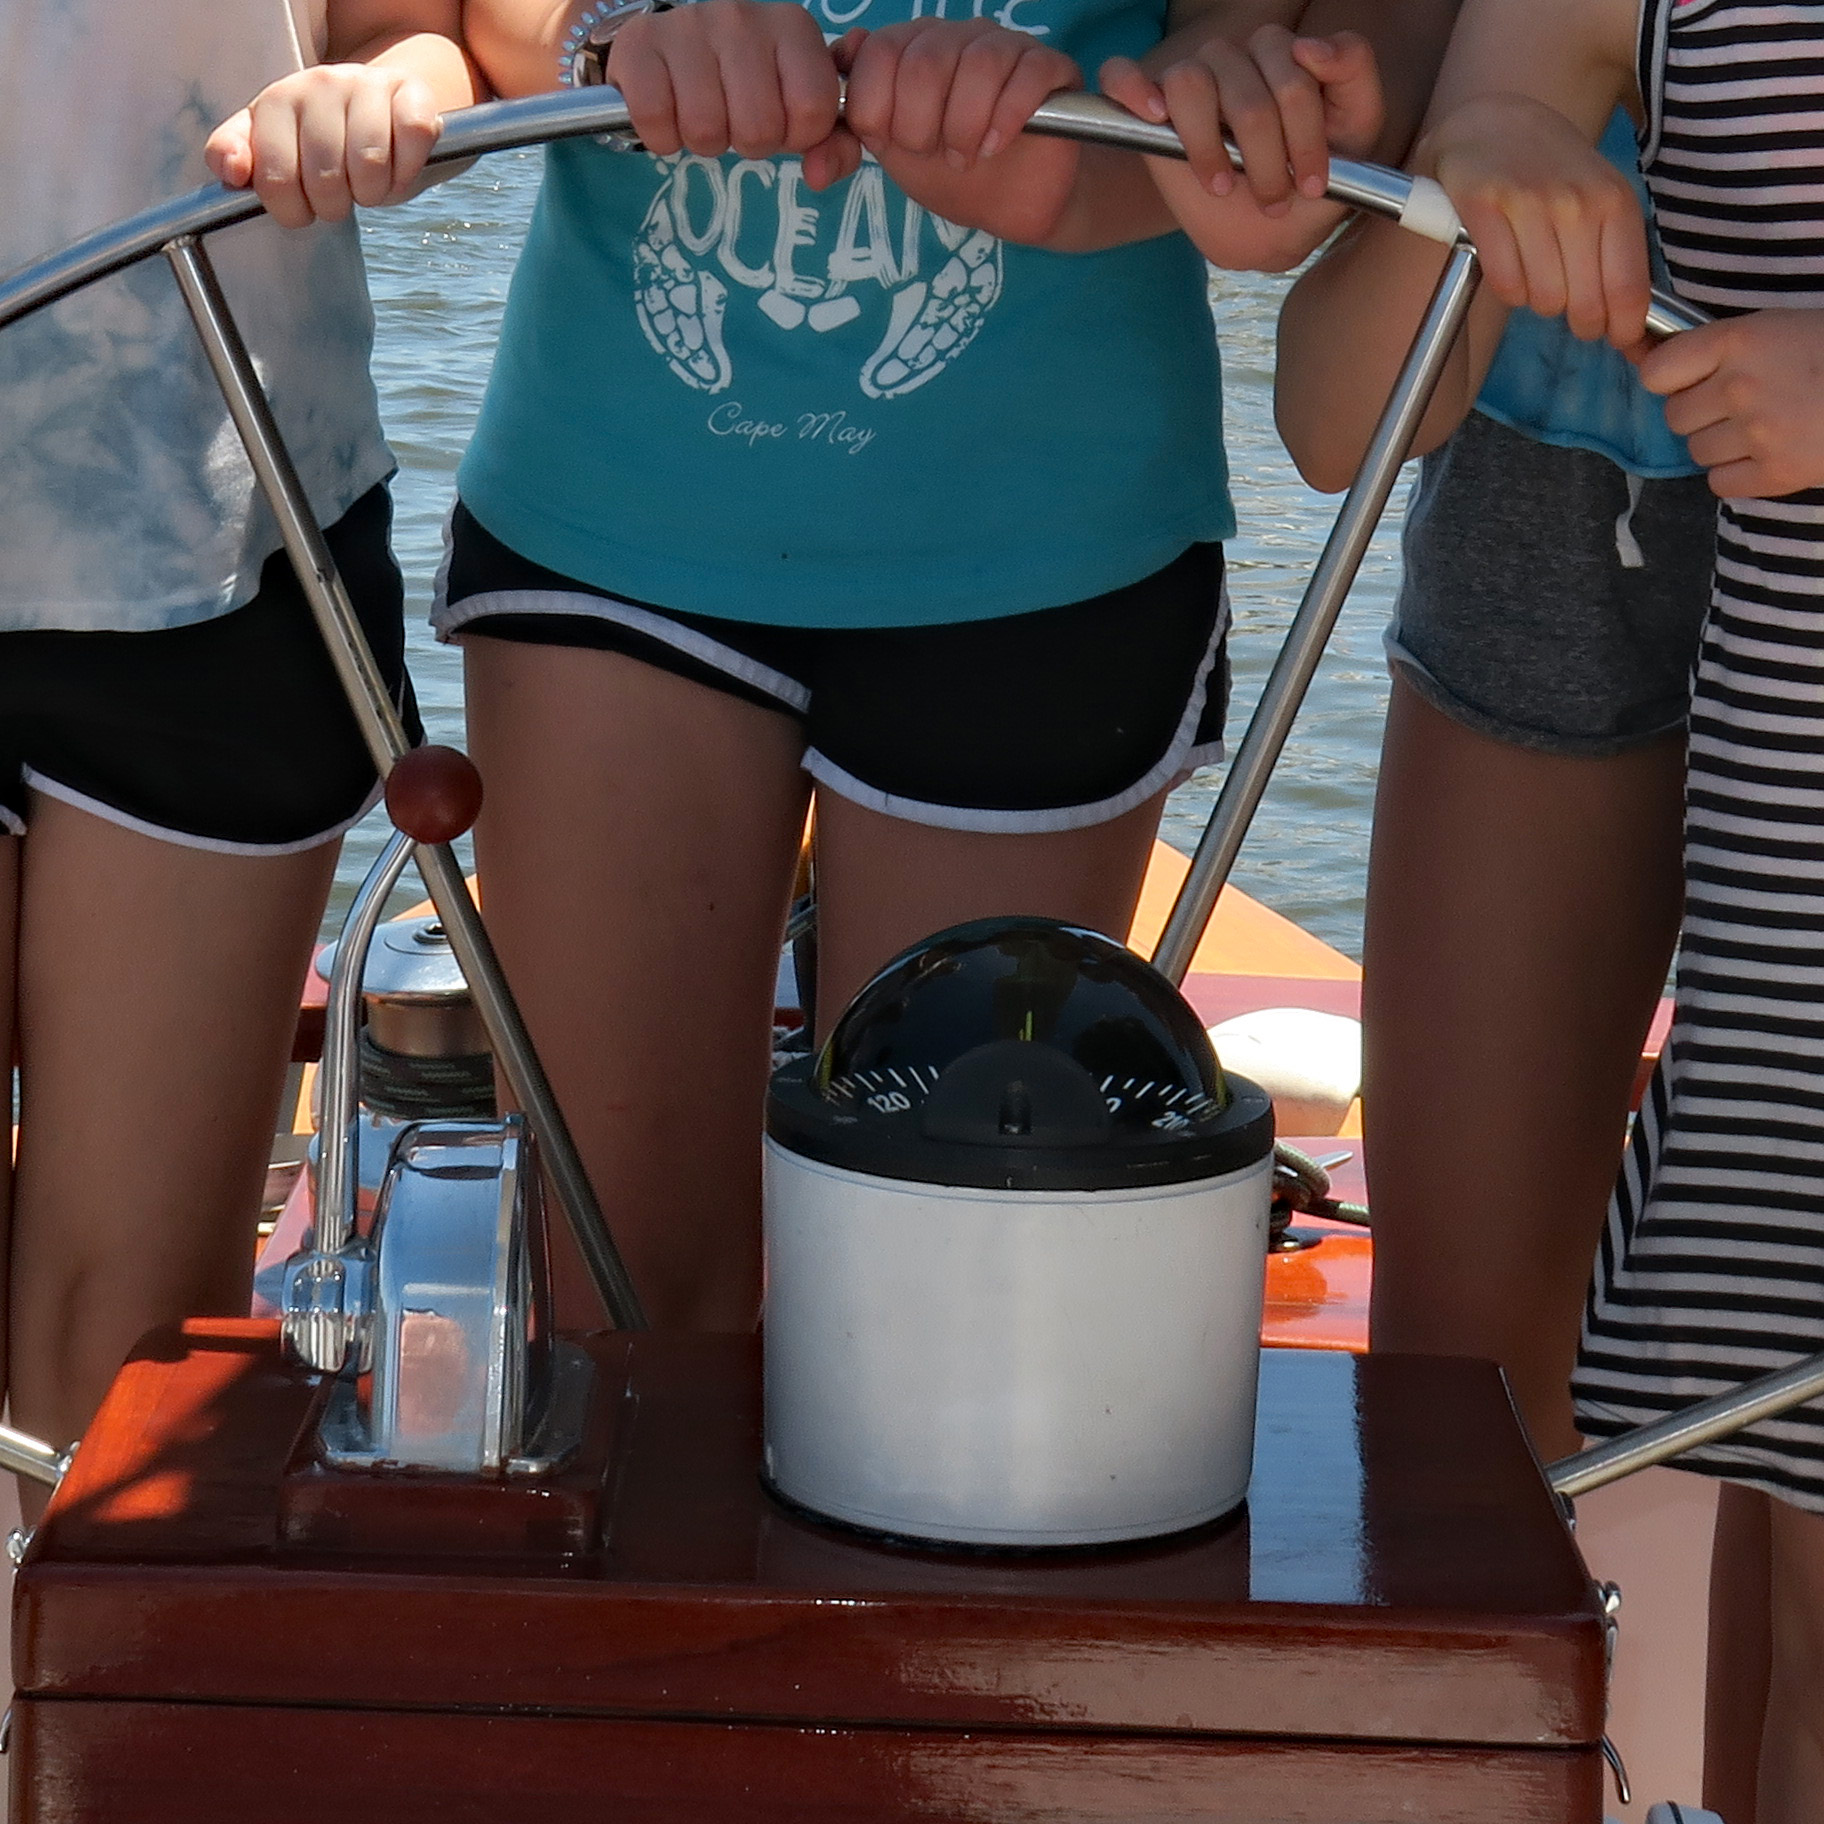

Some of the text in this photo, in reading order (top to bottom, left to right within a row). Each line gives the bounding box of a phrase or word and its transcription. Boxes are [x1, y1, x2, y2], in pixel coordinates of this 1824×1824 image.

[707, 401, 876, 455] Cape May
[866, 1090, 912, 1114] 120
